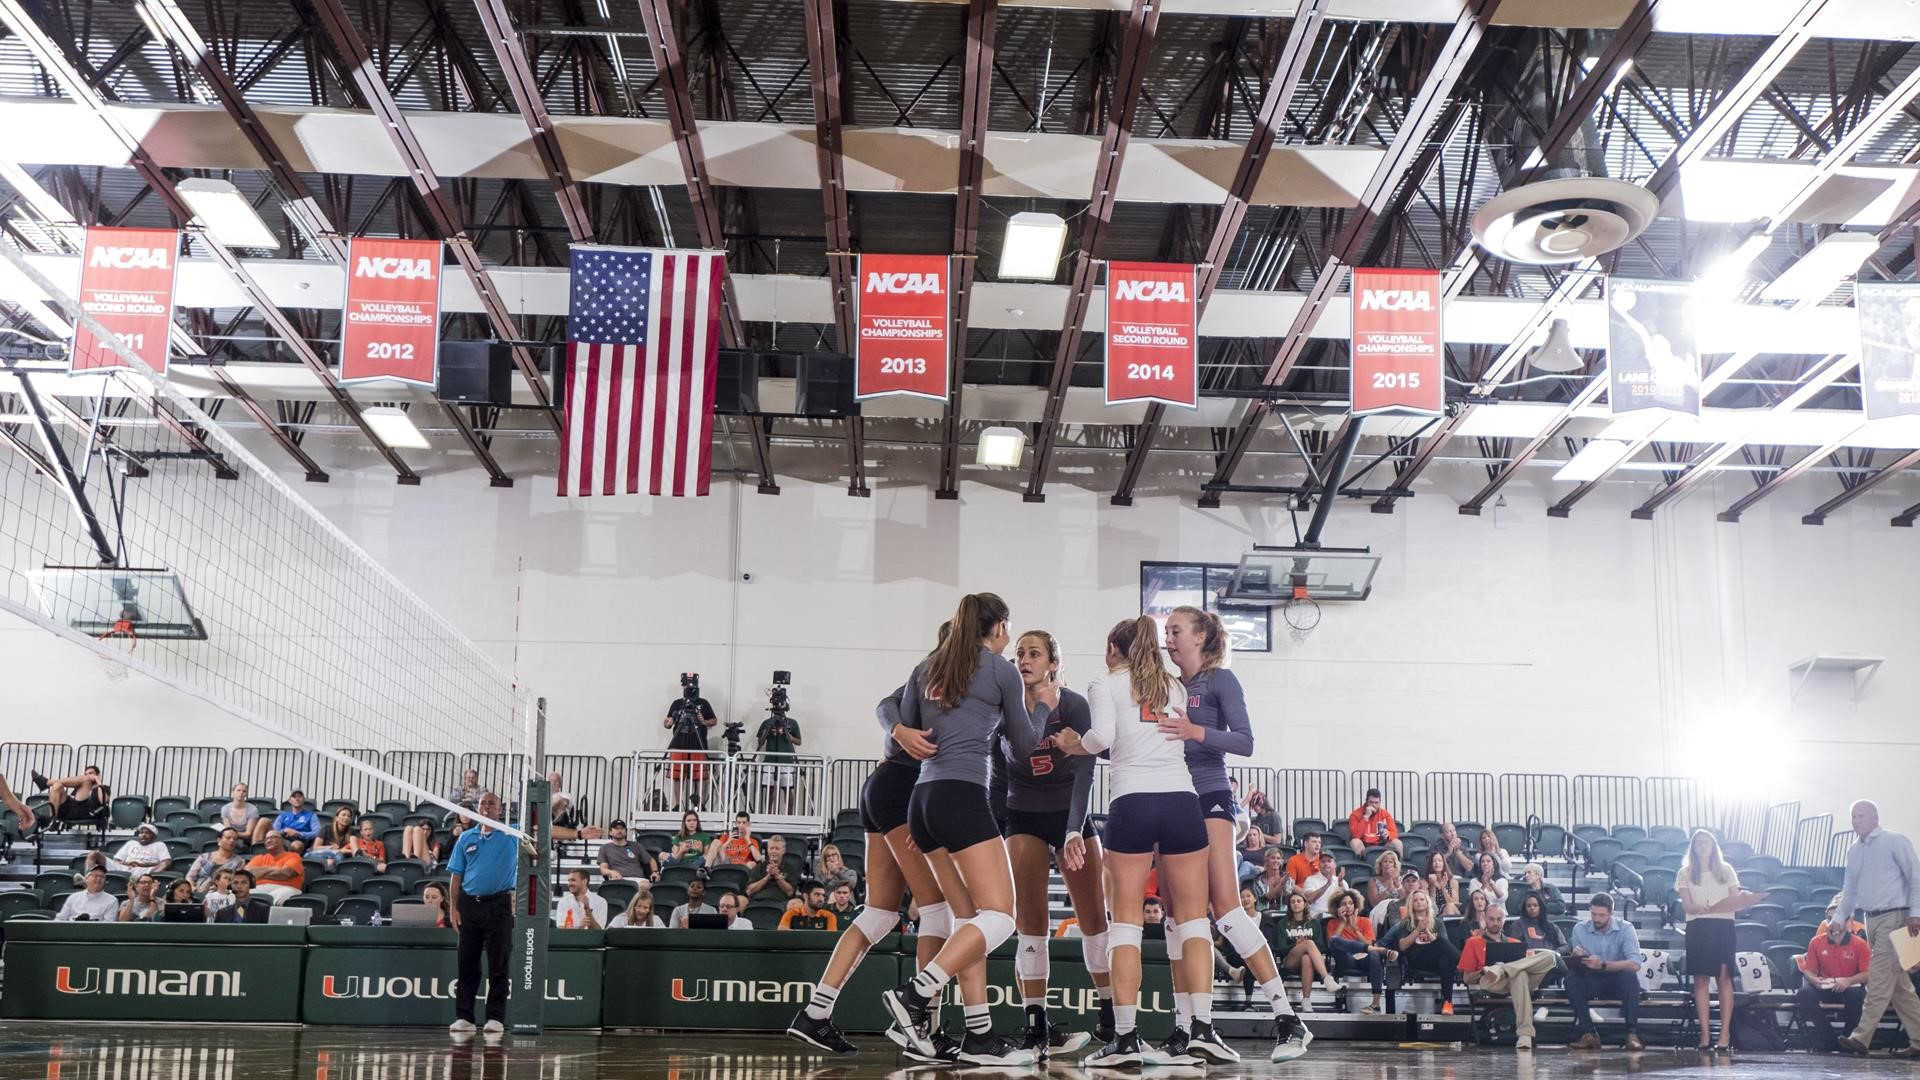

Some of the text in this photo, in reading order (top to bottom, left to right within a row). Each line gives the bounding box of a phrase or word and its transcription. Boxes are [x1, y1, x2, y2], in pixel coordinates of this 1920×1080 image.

[89, 246, 168, 269] NCAA
[355, 256, 432, 280] NCAA
[865, 272, 940, 294] NCAA
[1115, 280, 1186, 302] NCAA
[94, 293, 156, 303] VOLLEYBALL
[1360, 289, 1431, 311] NCAA
[83, 302, 165, 314] SECOND ROUND
[361, 303, 422, 314] VOLLEYBALL
[349, 312, 432, 324] CHAMPIONSHIPS
[873, 318, 932, 328] VOLLEYBALL
[862, 329, 943, 338] CHAMPIONSHIPS
[1122, 326, 1179, 336] VOLLEYBALL
[1367, 334, 1424, 344] VOLLEYBALL
[1112, 335, 1188, 345] SECOND ROUND
[1357, 344, 1435, 353] CHAMPIONSHIPS
[367, 342, 414, 360] 2012
[880, 357, 927, 374] 2013
[1127, 363, 1175, 380] 2014
[1373, 372, 1421, 389] 2015
[1030, 755, 1054, 776] 5
[524, 928, 535, 990] sports imports
[362, 976, 576, 1004] VOLLELL
[713, 979, 817, 1003] MIAM
[954, 984, 1171, 1014] OLEYBLL
